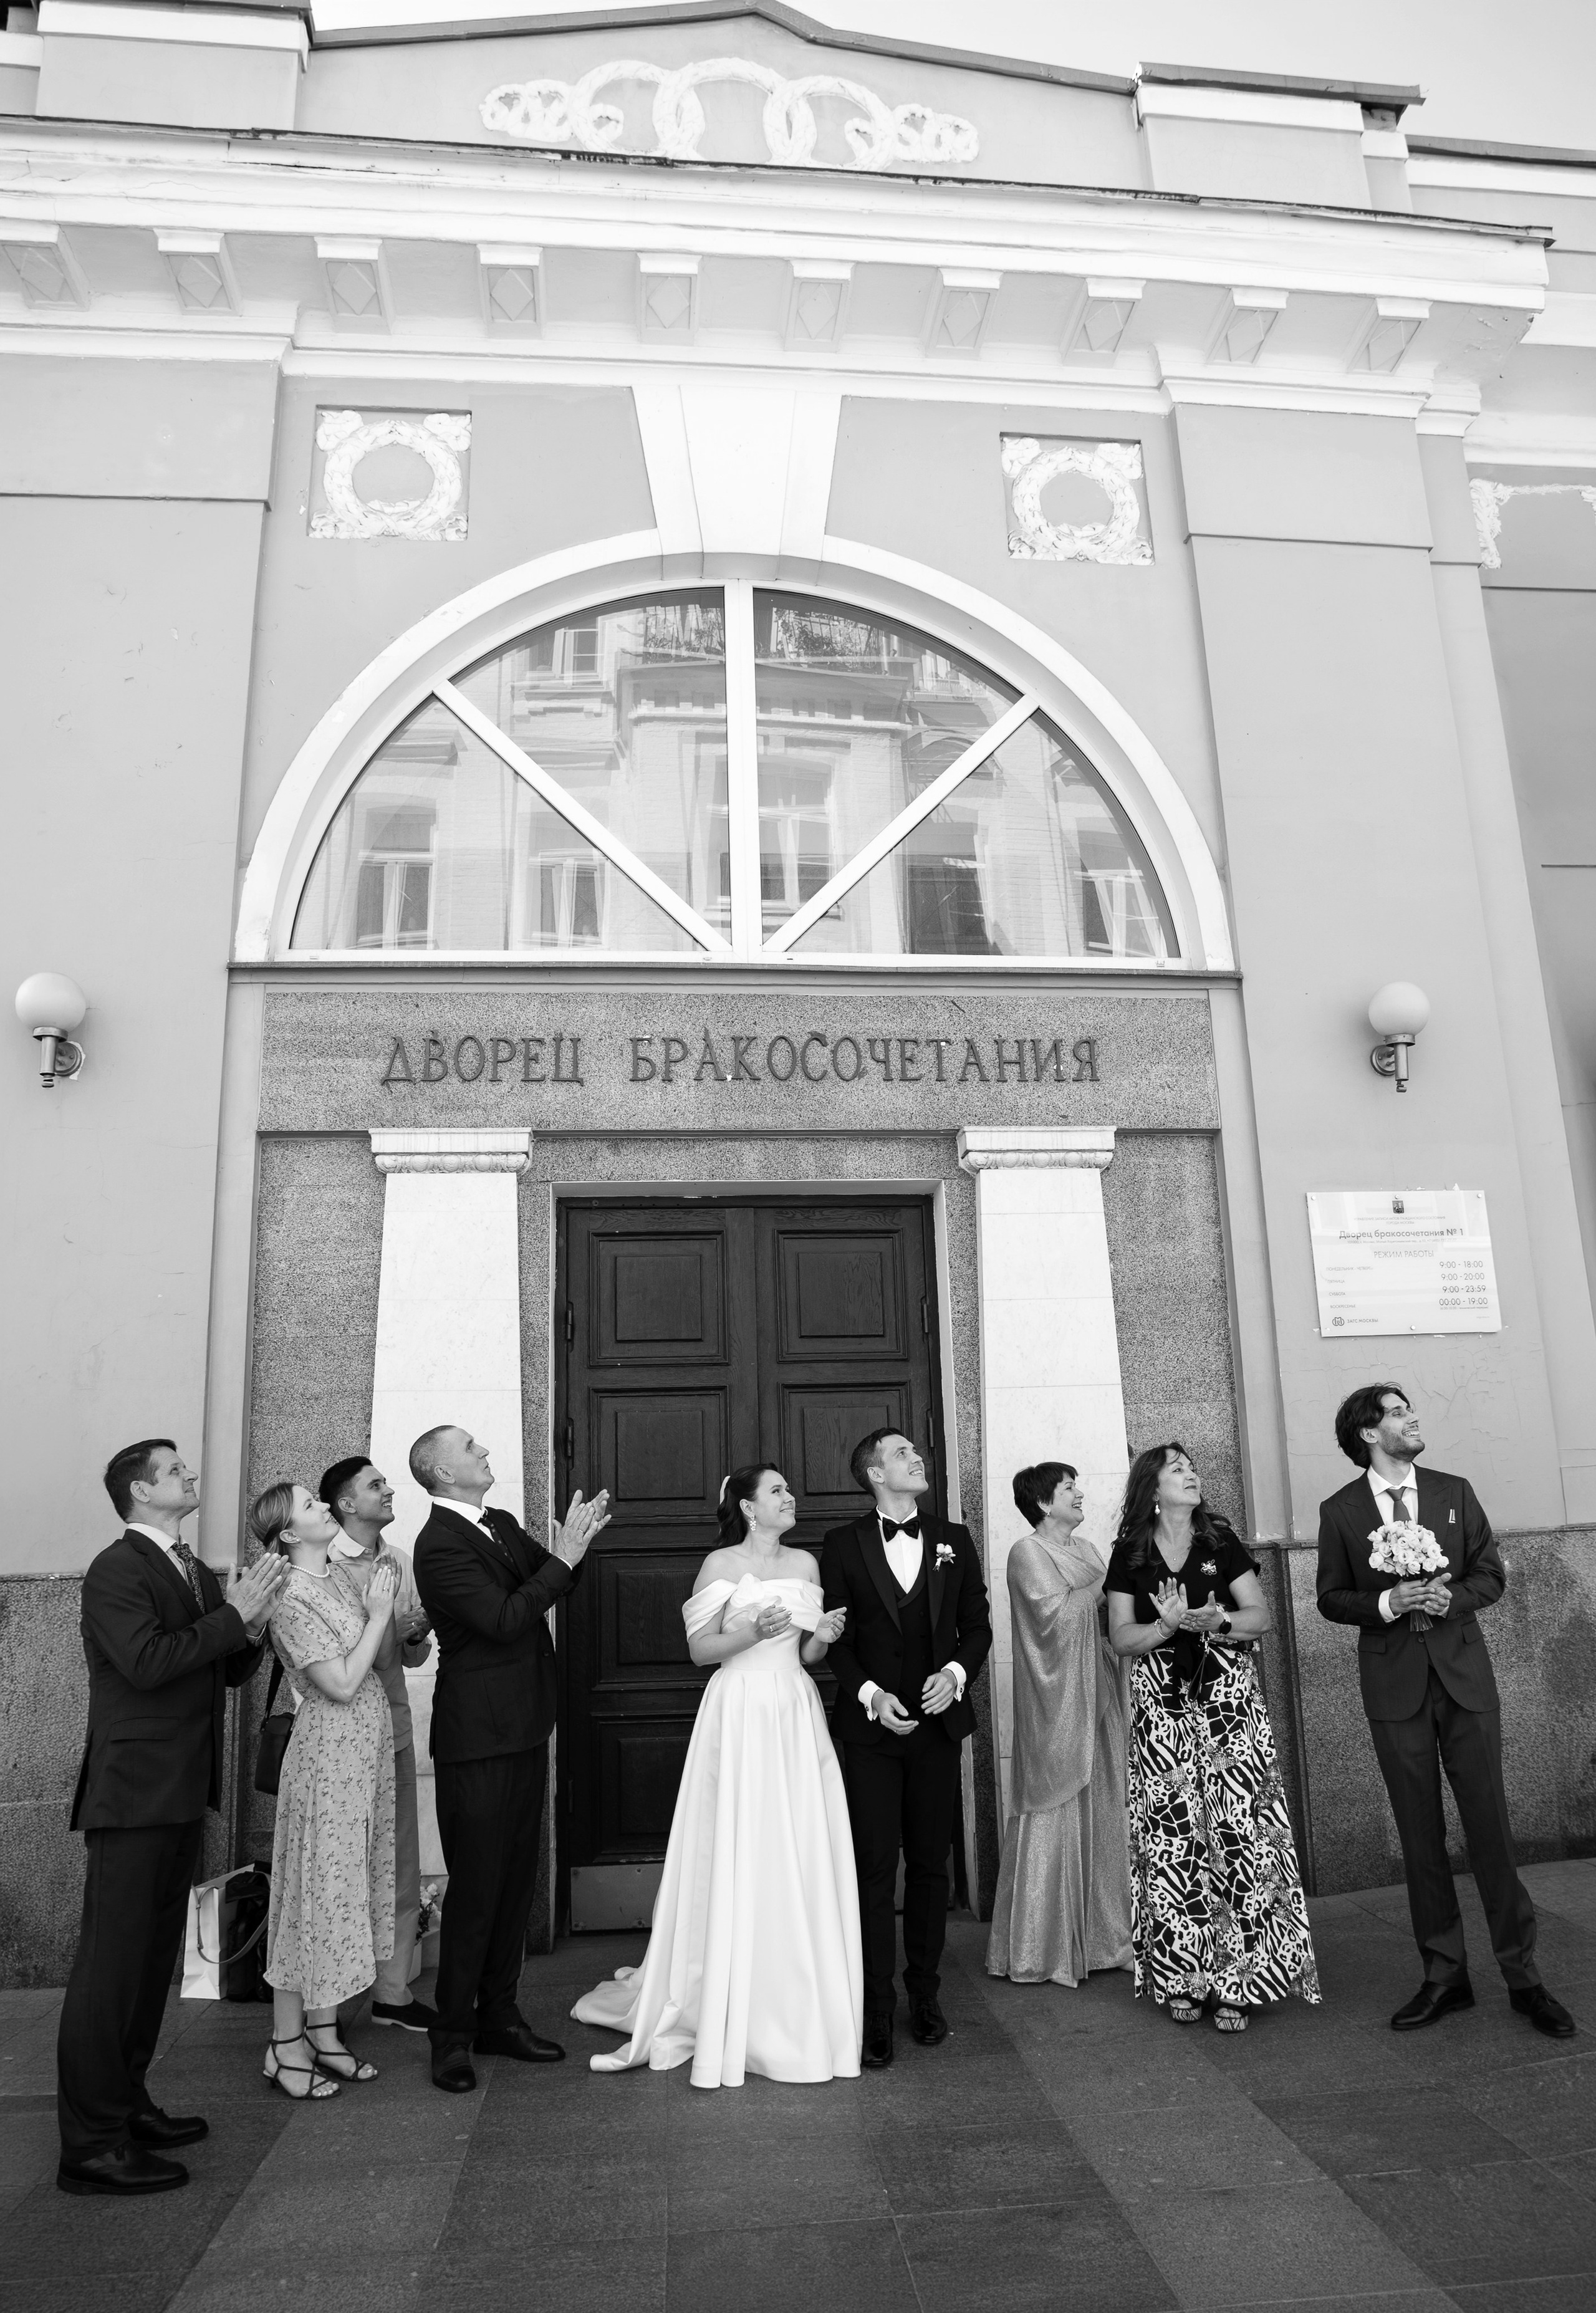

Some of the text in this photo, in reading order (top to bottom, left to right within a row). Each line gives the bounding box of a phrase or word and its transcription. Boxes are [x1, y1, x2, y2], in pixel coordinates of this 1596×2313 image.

[381, 1032, 1100, 1087] ДВОРЕЦ БРАКОСОЧЕТАНИЯ
[1339, 1231, 1372, 1239] Дворец
[1374, 1229, 1445, 1239] бракосочетания
